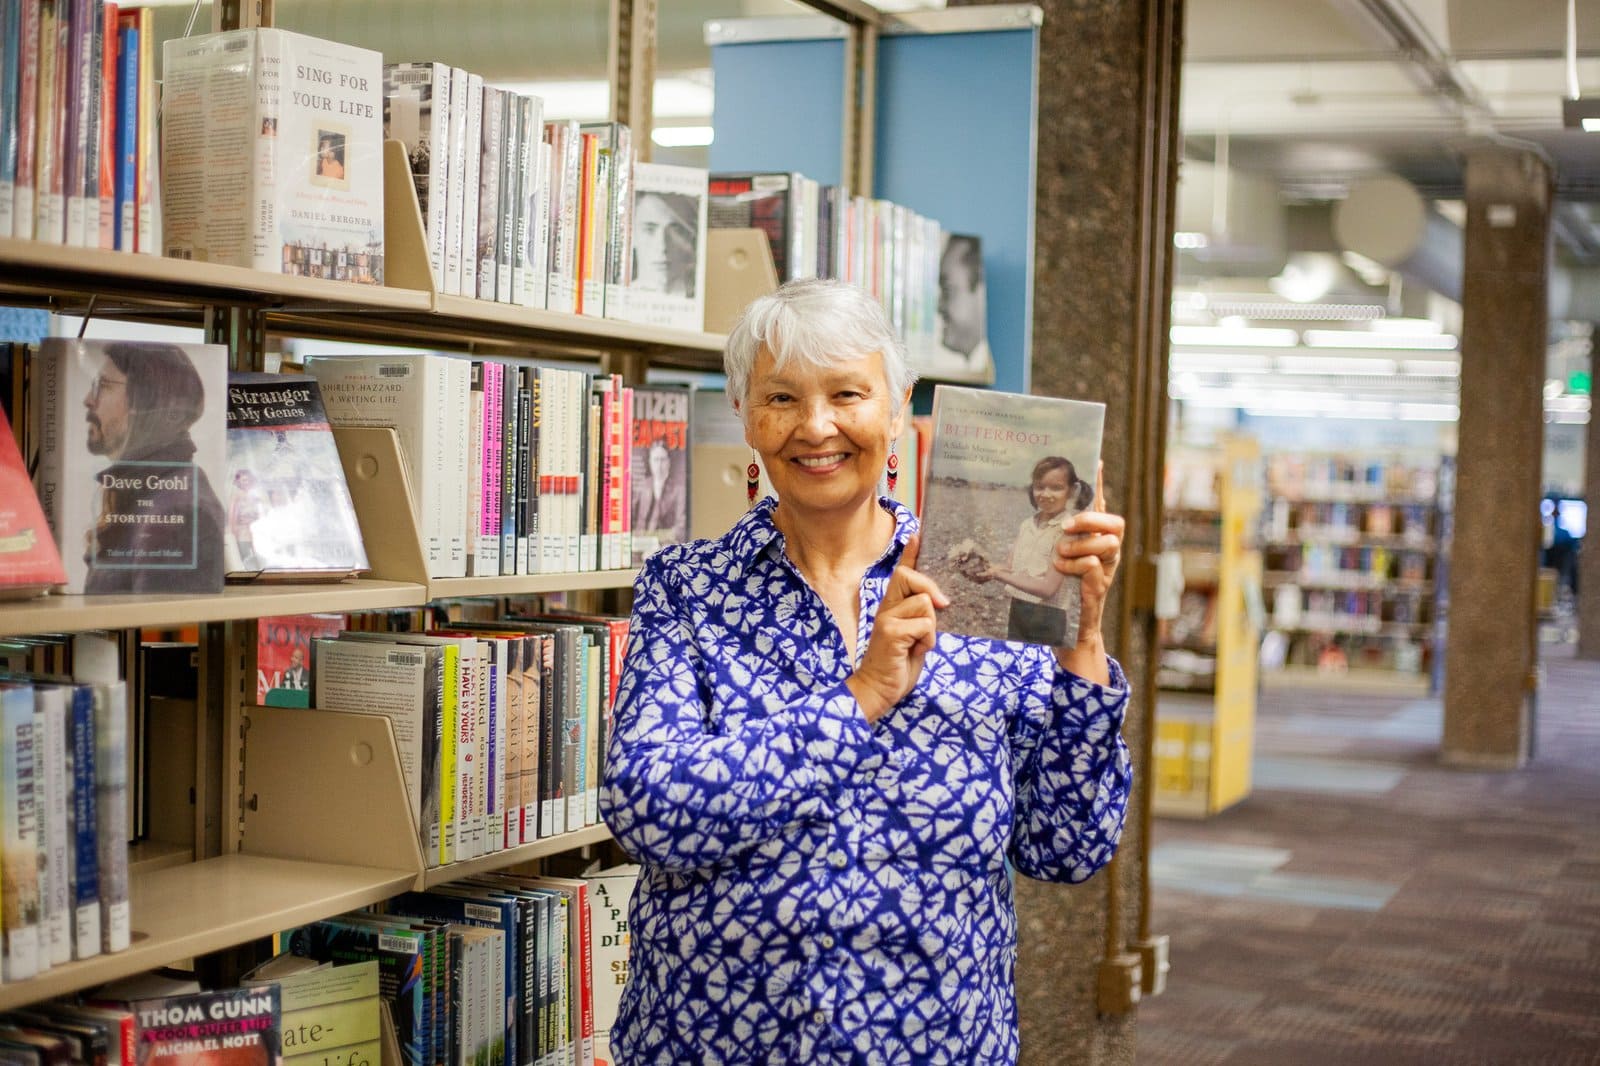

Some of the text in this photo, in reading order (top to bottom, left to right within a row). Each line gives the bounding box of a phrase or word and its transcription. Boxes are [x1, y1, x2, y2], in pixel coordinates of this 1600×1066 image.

[296, 64, 369, 92] SING FOR
[292, 93, 375, 119] YOUR LIFE
[438, 74, 449, 137] PRINCE
[290, 209, 373, 227] DANIEL BERGNER
[486, 216, 496, 256] FACE
[503, 213, 513, 258] THIS UP
[516, 216, 526, 260] THIS UP
[230, 387, 312, 406] Stranger
[321, 383, 402, 393] SHIRLEY HAZZARD
[338, 395, 376, 404] WRITING
[379, 396, 398, 404] LIFE
[532, 377, 542, 428] LEVON
[45, 364, 57, 453] STORYTELLER
[238, 404, 306, 423] My Genes
[944, 423, 1052, 446] BITTERROOT
[102, 474, 188, 491] Dave Grohl
[105, 513, 185, 525] STORYTELLER
[137, 498, 154, 508] THE
[437, 655, 446, 682] WILD
[462, 666, 471, 698] HAVE
[489, 673, 497, 700] JIMI
[574, 634, 583, 714] WINTER KING
[478, 657, 488, 726] Troubled
[435, 711, 443, 740] HOME
[460, 711, 471, 745] YOURS
[489, 701, 497, 754] HENDRIX
[510, 694, 519, 763] MARIA
[525, 691, 535, 760] MARIA
[35, 732, 45, 781] SECONDS
[545, 730, 553, 763] PRINCE
[15, 722, 35, 840] GRINNELL
[76, 722, 88, 834] RIGHT TIME
[460, 772, 469, 821] HENDERSON
[35, 800, 46, 849] COURAGE
[475, 920, 495, 928] HERSH
[422, 938, 432, 994] MARCELO
[435, 932, 446, 989] MARCELO
[524, 906, 535, 1016] THE DISSIDENT
[539, 957, 548, 998] HERZOG
[550, 955, 561, 995] HERZOG
[465, 959, 474, 1050] JAMES HERRIOT
[494, 944, 503, 1033] JAMES HERRIOT
[138, 996, 272, 1028] THOM GUNN
[154, 1026, 193, 1041] COOL
[197, 1019, 243, 1036] QUEER
[244, 1016, 273, 1031] LIFE
[155, 1036, 220, 1057] MICHAEL
[222, 1033, 260, 1051] NOTT
